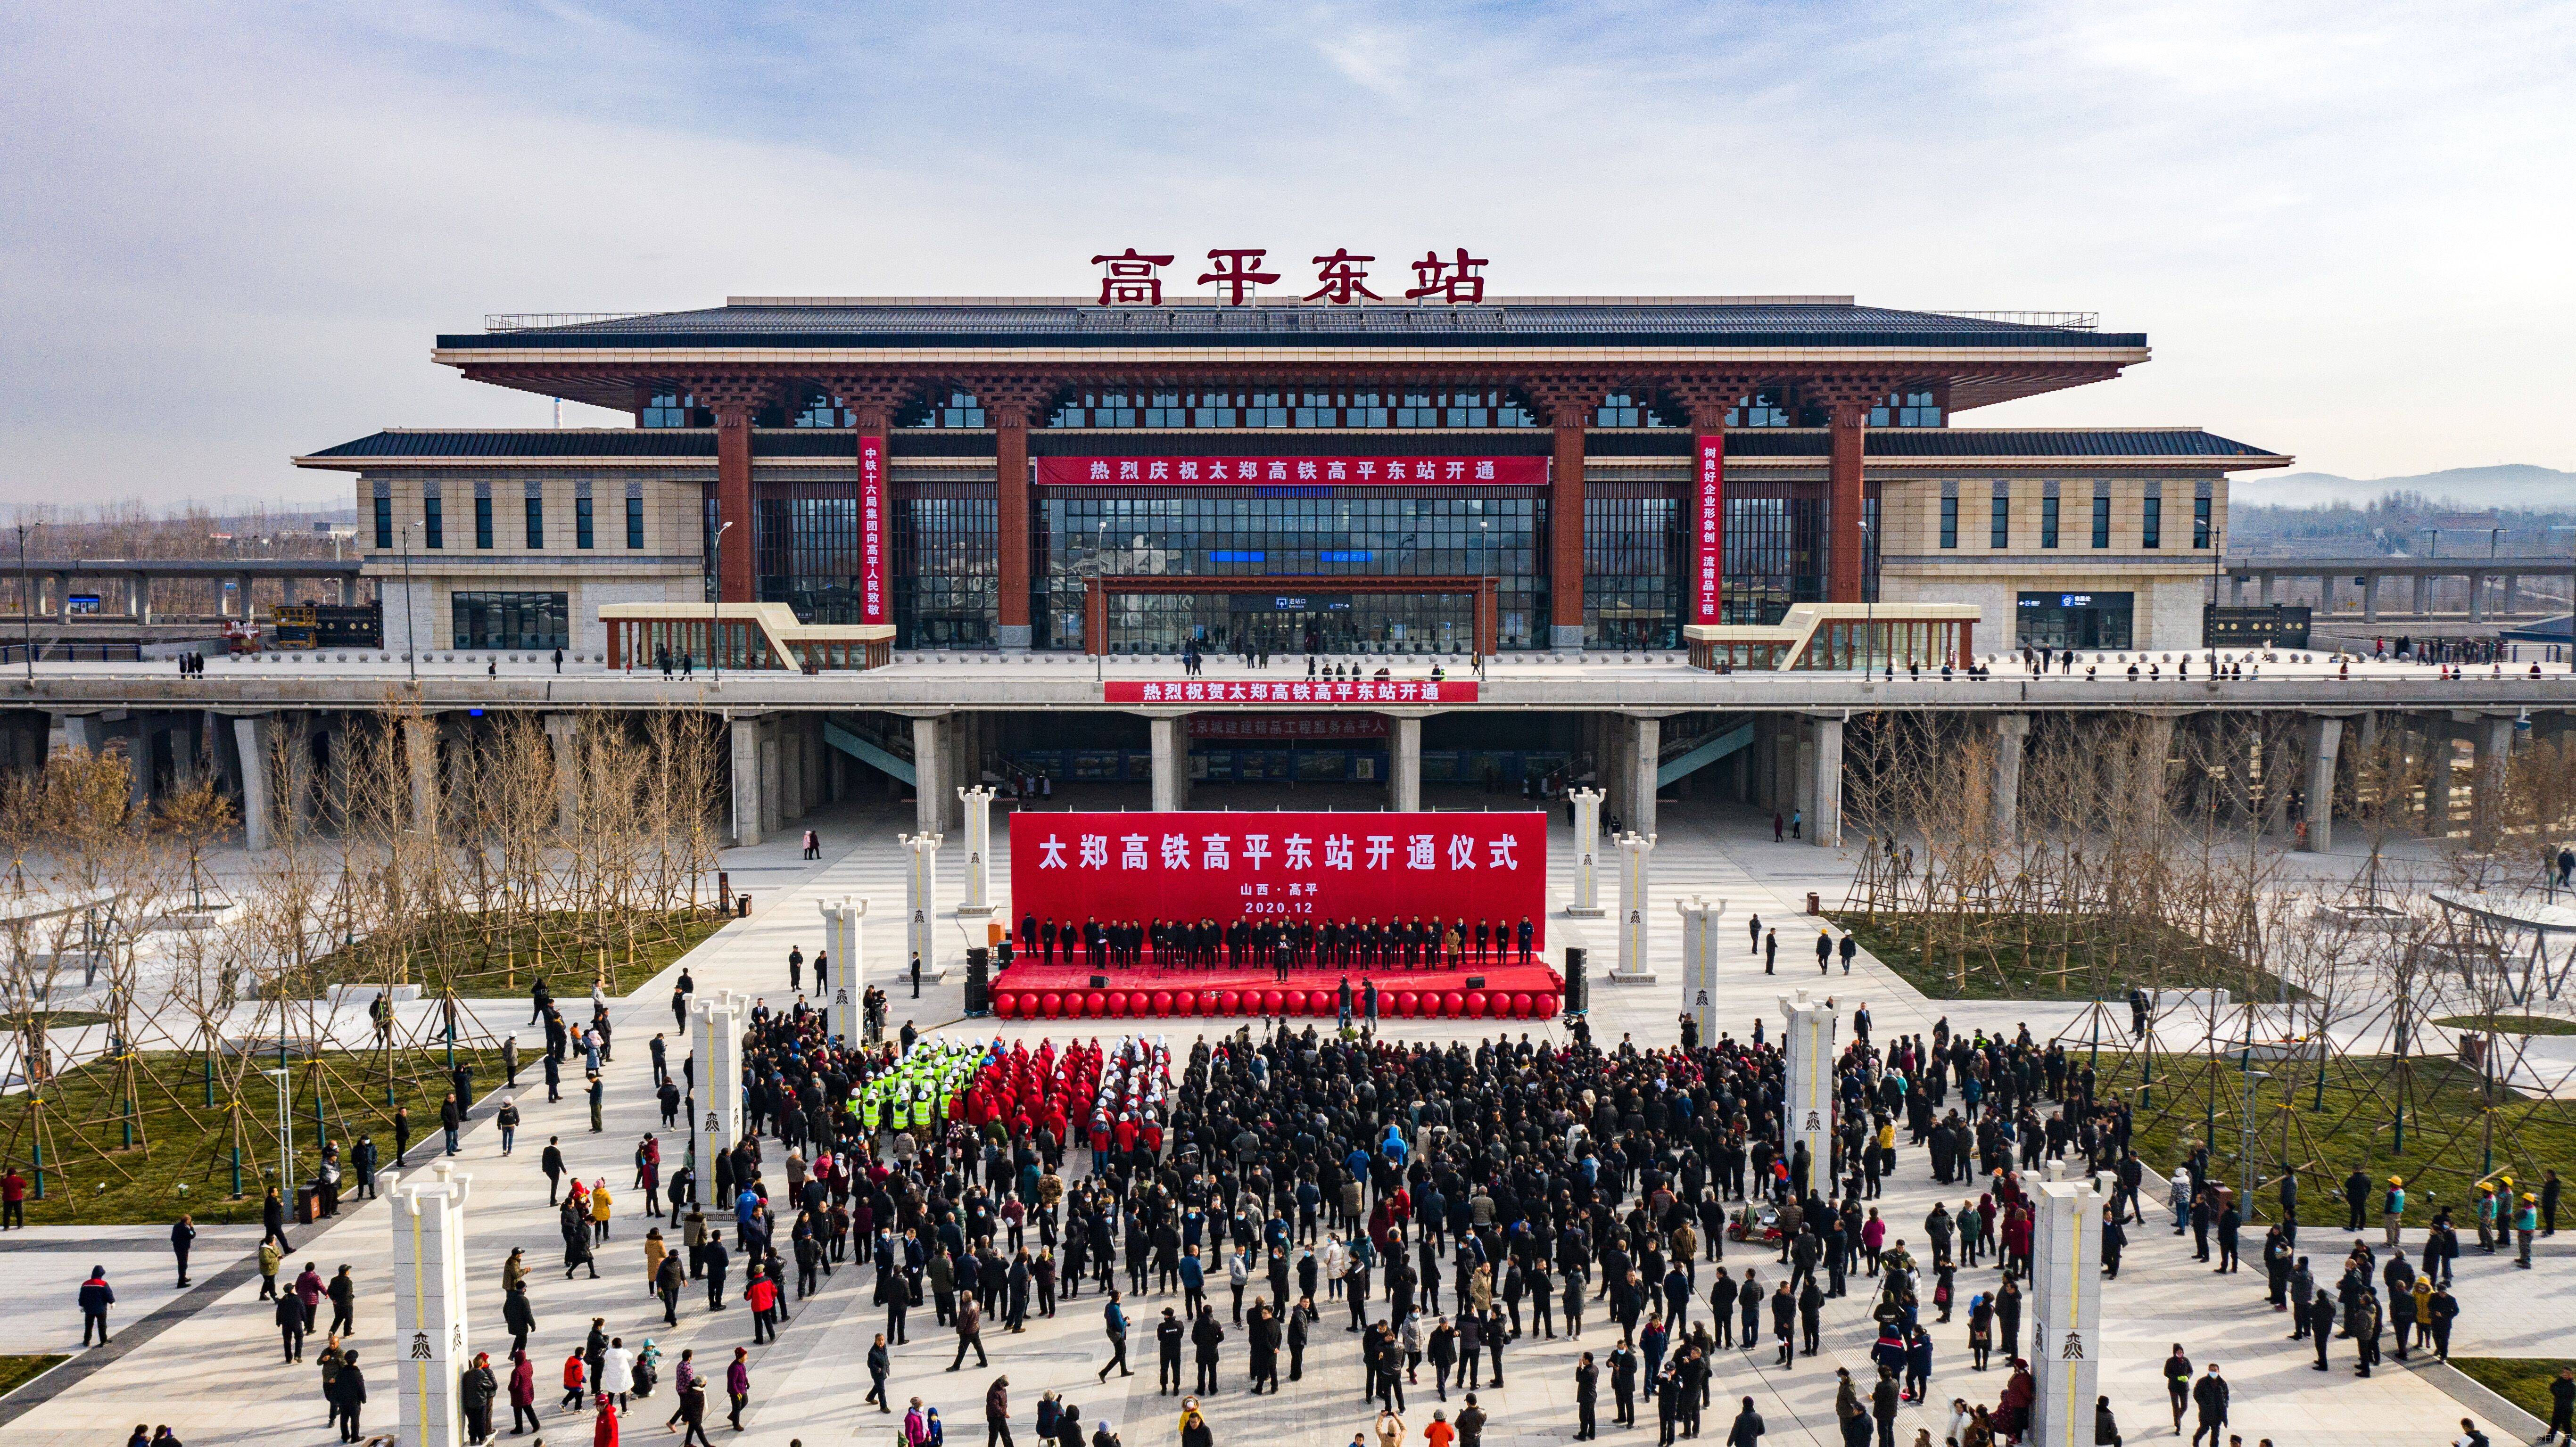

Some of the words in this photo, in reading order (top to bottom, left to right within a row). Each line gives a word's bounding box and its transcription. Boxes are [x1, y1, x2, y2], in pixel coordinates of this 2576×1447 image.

[1091, 247, 1489, 305] 高平东站
[1090, 460, 1494, 480] 热烈庆祝太郑高铁高平东站开通
[865, 448, 879, 615] 中铁十六局集团向高平人民致敬
[1702, 447, 1717, 615] 树良好企业形象创一流精品工程
[1143, 682, 1439, 701] 热烈祝贺太郑高铁高平东站开通
[1039, 832, 1519, 871] 太郑高铁高平东站开通仪式
[1240, 883, 1318, 896] 山西·高平
[1246, 902, 1312, 913] 2020.12
